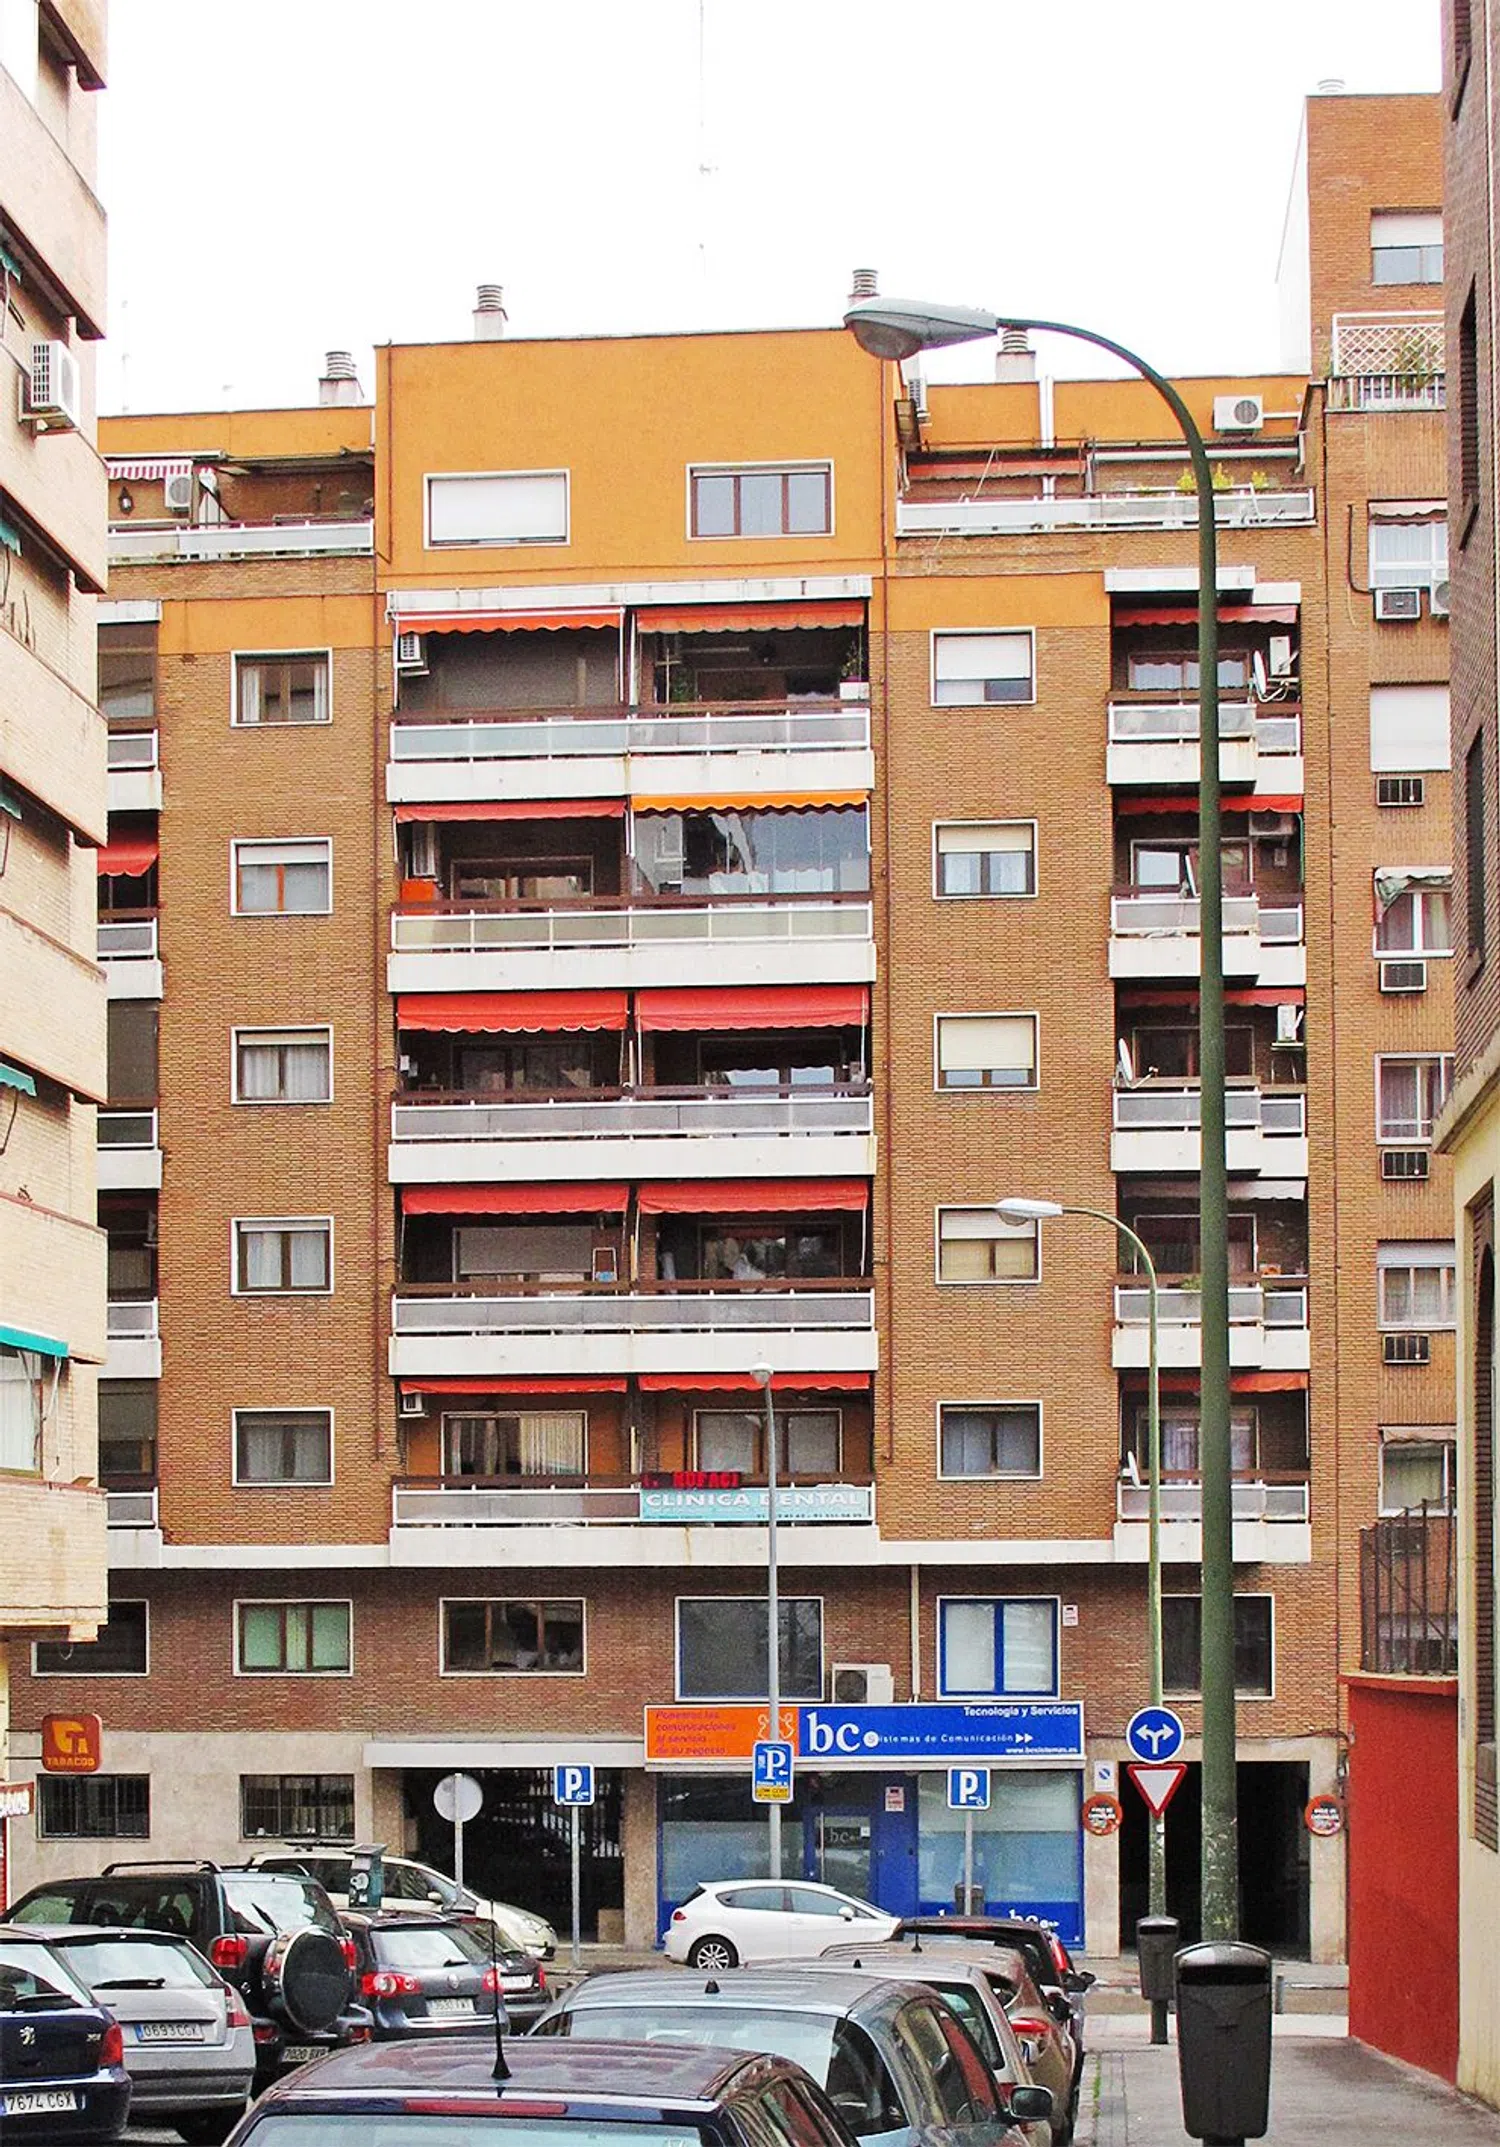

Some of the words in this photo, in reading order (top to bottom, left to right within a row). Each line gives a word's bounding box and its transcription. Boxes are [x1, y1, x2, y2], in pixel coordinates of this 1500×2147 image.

[760, 1493, 861, 1506] DENTAL
[1021, 1708, 1029, 1718] y
[1030, 1706, 1078, 1716] Servicios
[806, 1711, 860, 1752] bc
[924, 1734, 937, 1743] de
[46, 1757, 95, 1767] TABACOS
[763, 1749, 786, 1780] P
[565, 1768, 582, 1800] P
[960, 1771, 979, 1804] P
[8, 2094, 43, 2111] 7674
